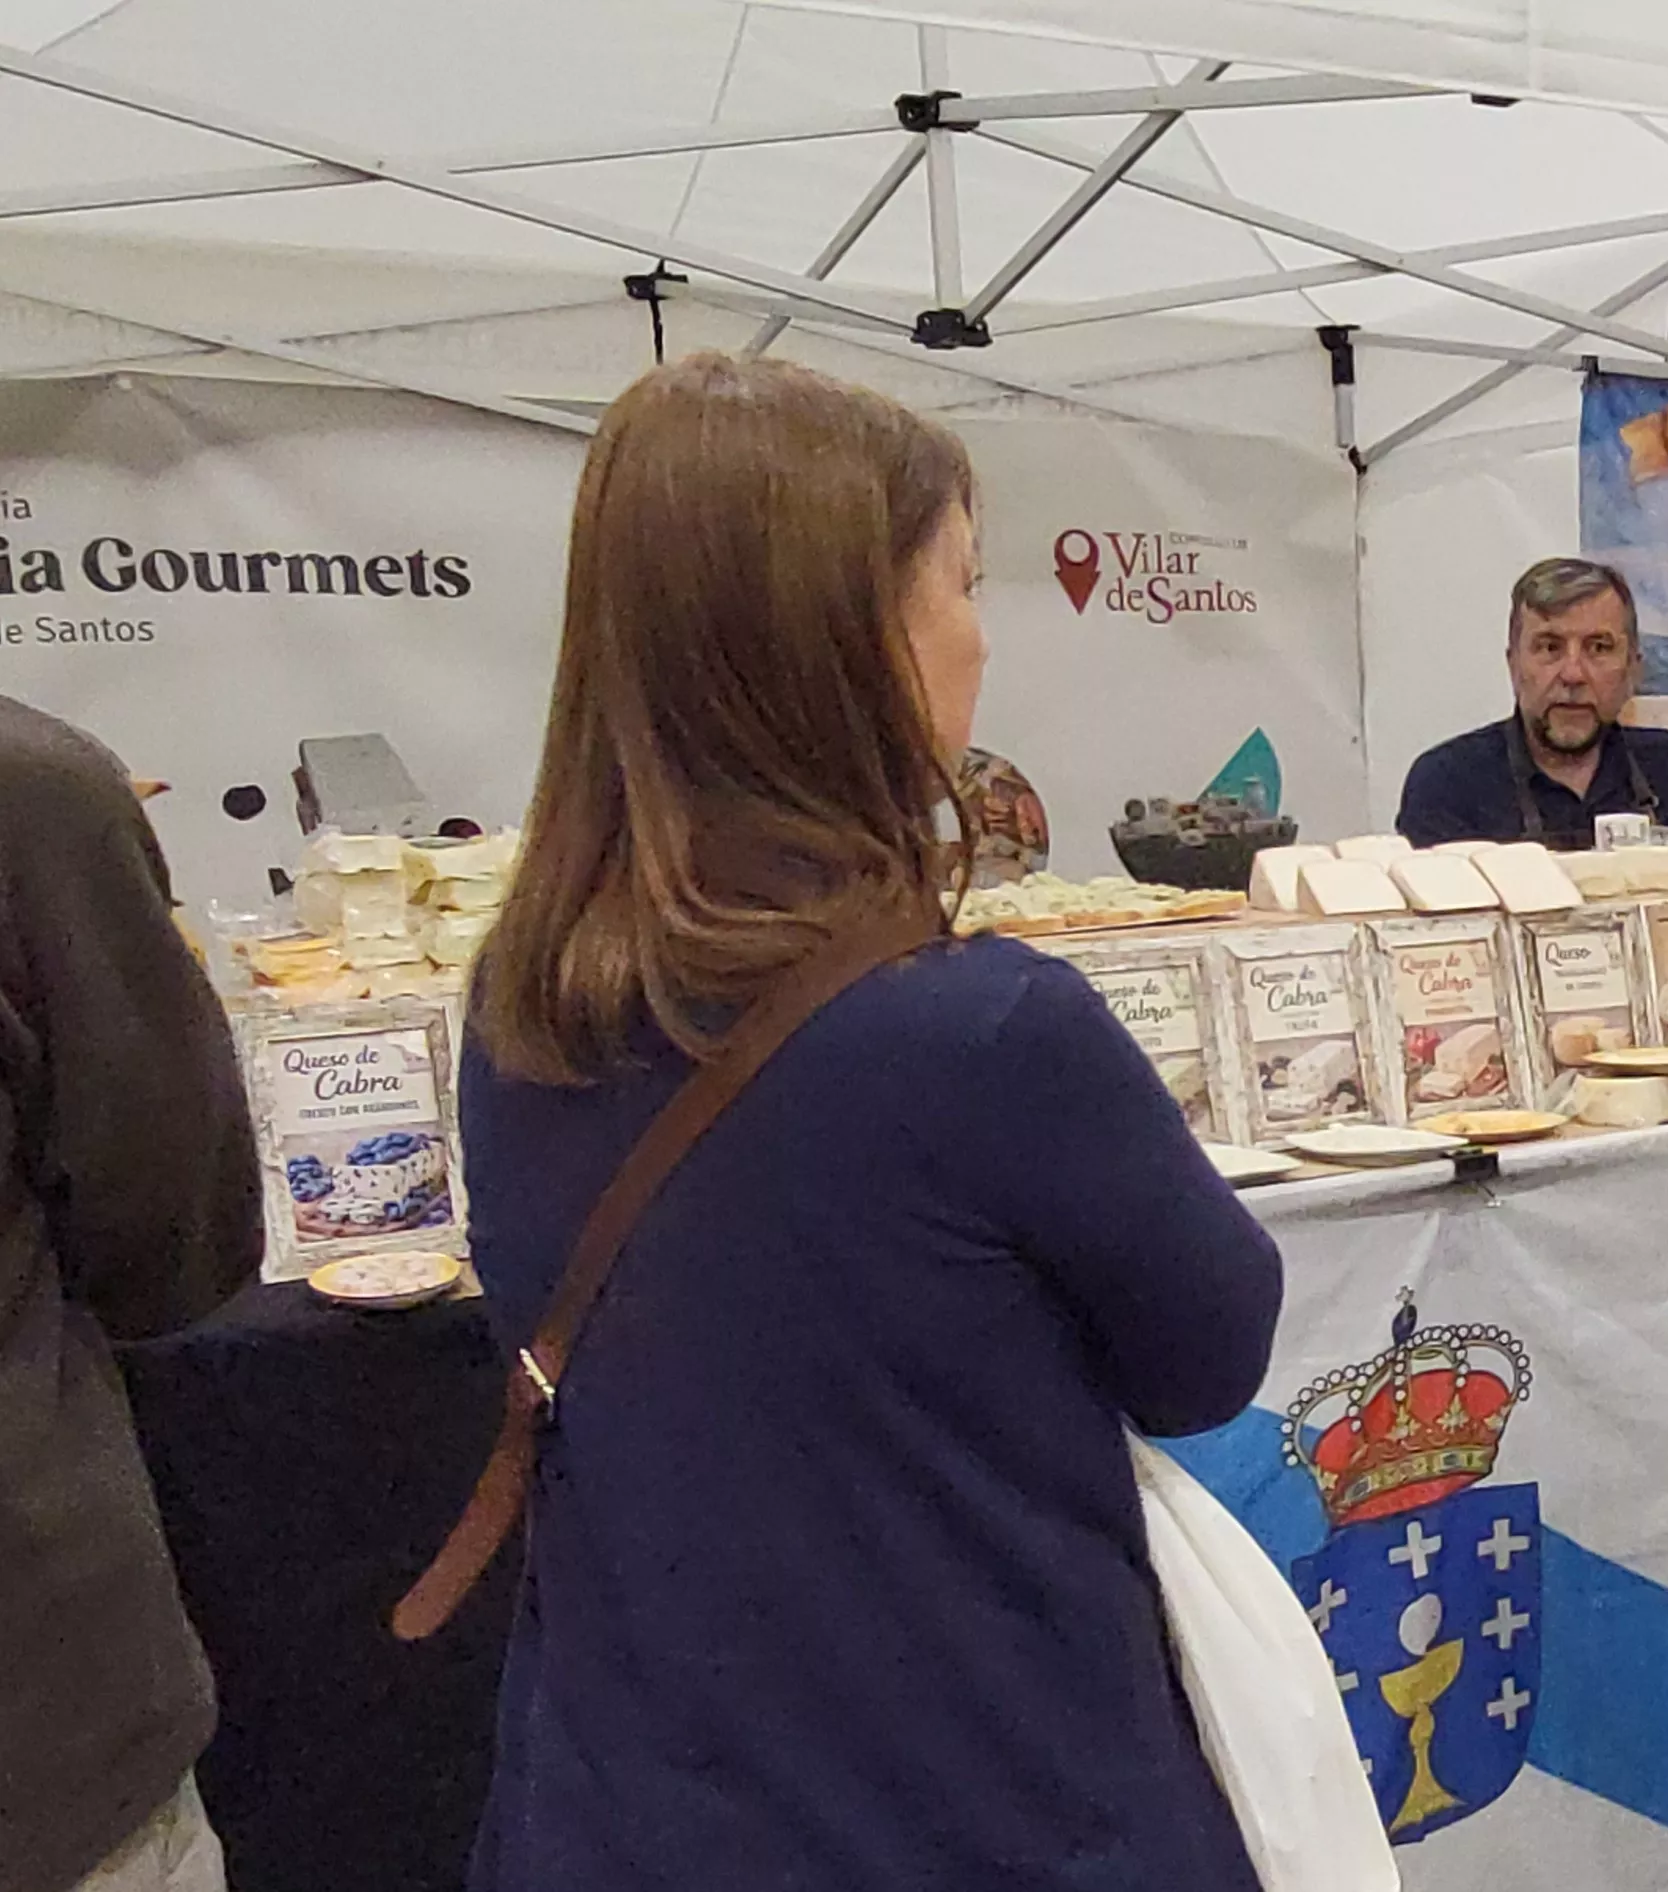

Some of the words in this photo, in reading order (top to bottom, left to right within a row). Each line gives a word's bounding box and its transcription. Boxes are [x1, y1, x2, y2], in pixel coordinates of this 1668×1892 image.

[81, 537, 472, 598] Gourmets
[1103, 532, 1199, 579] Vilar
[35, 616, 156, 644] Santos
[1545, 941, 1592, 967] Queso
[1113, 998, 1173, 1024] Cabra
[1266, 981, 1329, 1013] Cabra
[284, 1048, 350, 1076] Queso
[354, 1044, 380, 1065] de
[313, 1067, 402, 1101] Cabra
